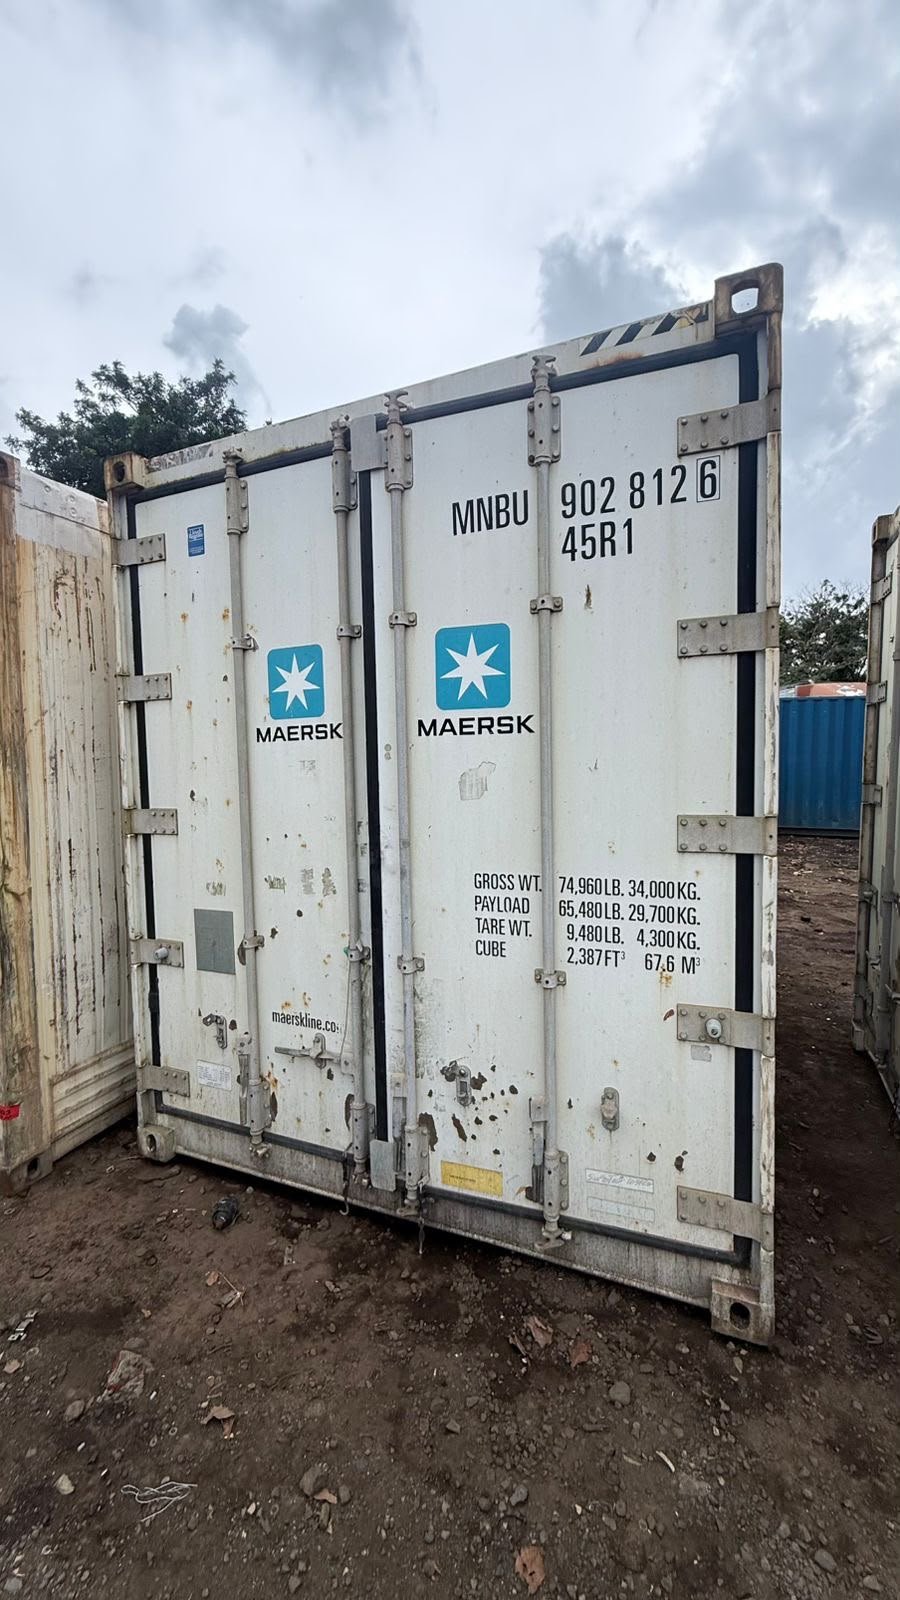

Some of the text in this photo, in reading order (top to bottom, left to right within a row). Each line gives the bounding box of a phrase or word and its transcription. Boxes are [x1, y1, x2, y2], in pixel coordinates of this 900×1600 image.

[451, 459, 717, 537] MNBU 902 812 6
[561, 517, 634, 562] 45R1
[256, 721, 343, 743] MAERSK
[417, 714, 535, 737] MAERSK
[474, 872, 515, 891] GROSS
[517, 874, 543, 893] WT.
[474, 895, 530, 914] PAYLOAD
[475, 917, 506, 936] TARE
[508, 919, 533, 938] WT.
[475, 939, 507, 958] CUBE
[644, 953, 675, 973] 67.6
[271, 1011, 341, 1034] maerskline.co
